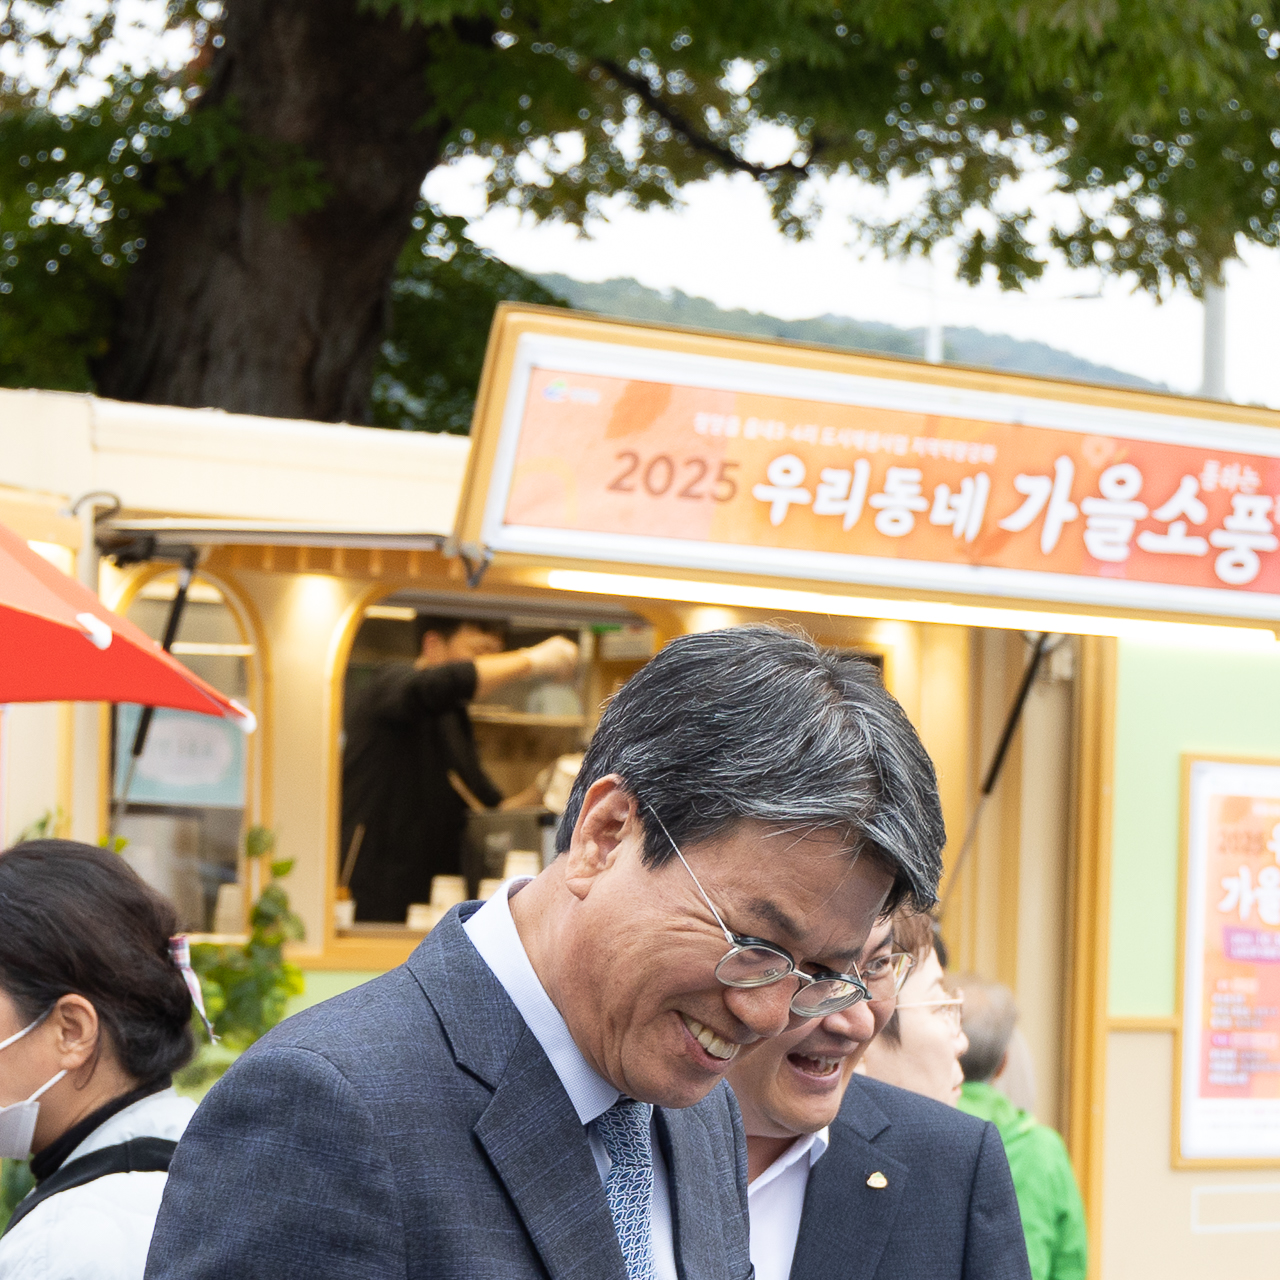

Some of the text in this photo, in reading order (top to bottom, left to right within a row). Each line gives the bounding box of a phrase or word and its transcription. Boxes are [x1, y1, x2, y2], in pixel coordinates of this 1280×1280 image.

[608, 449, 1280, 586] 2025 우리동네 가을소풍
